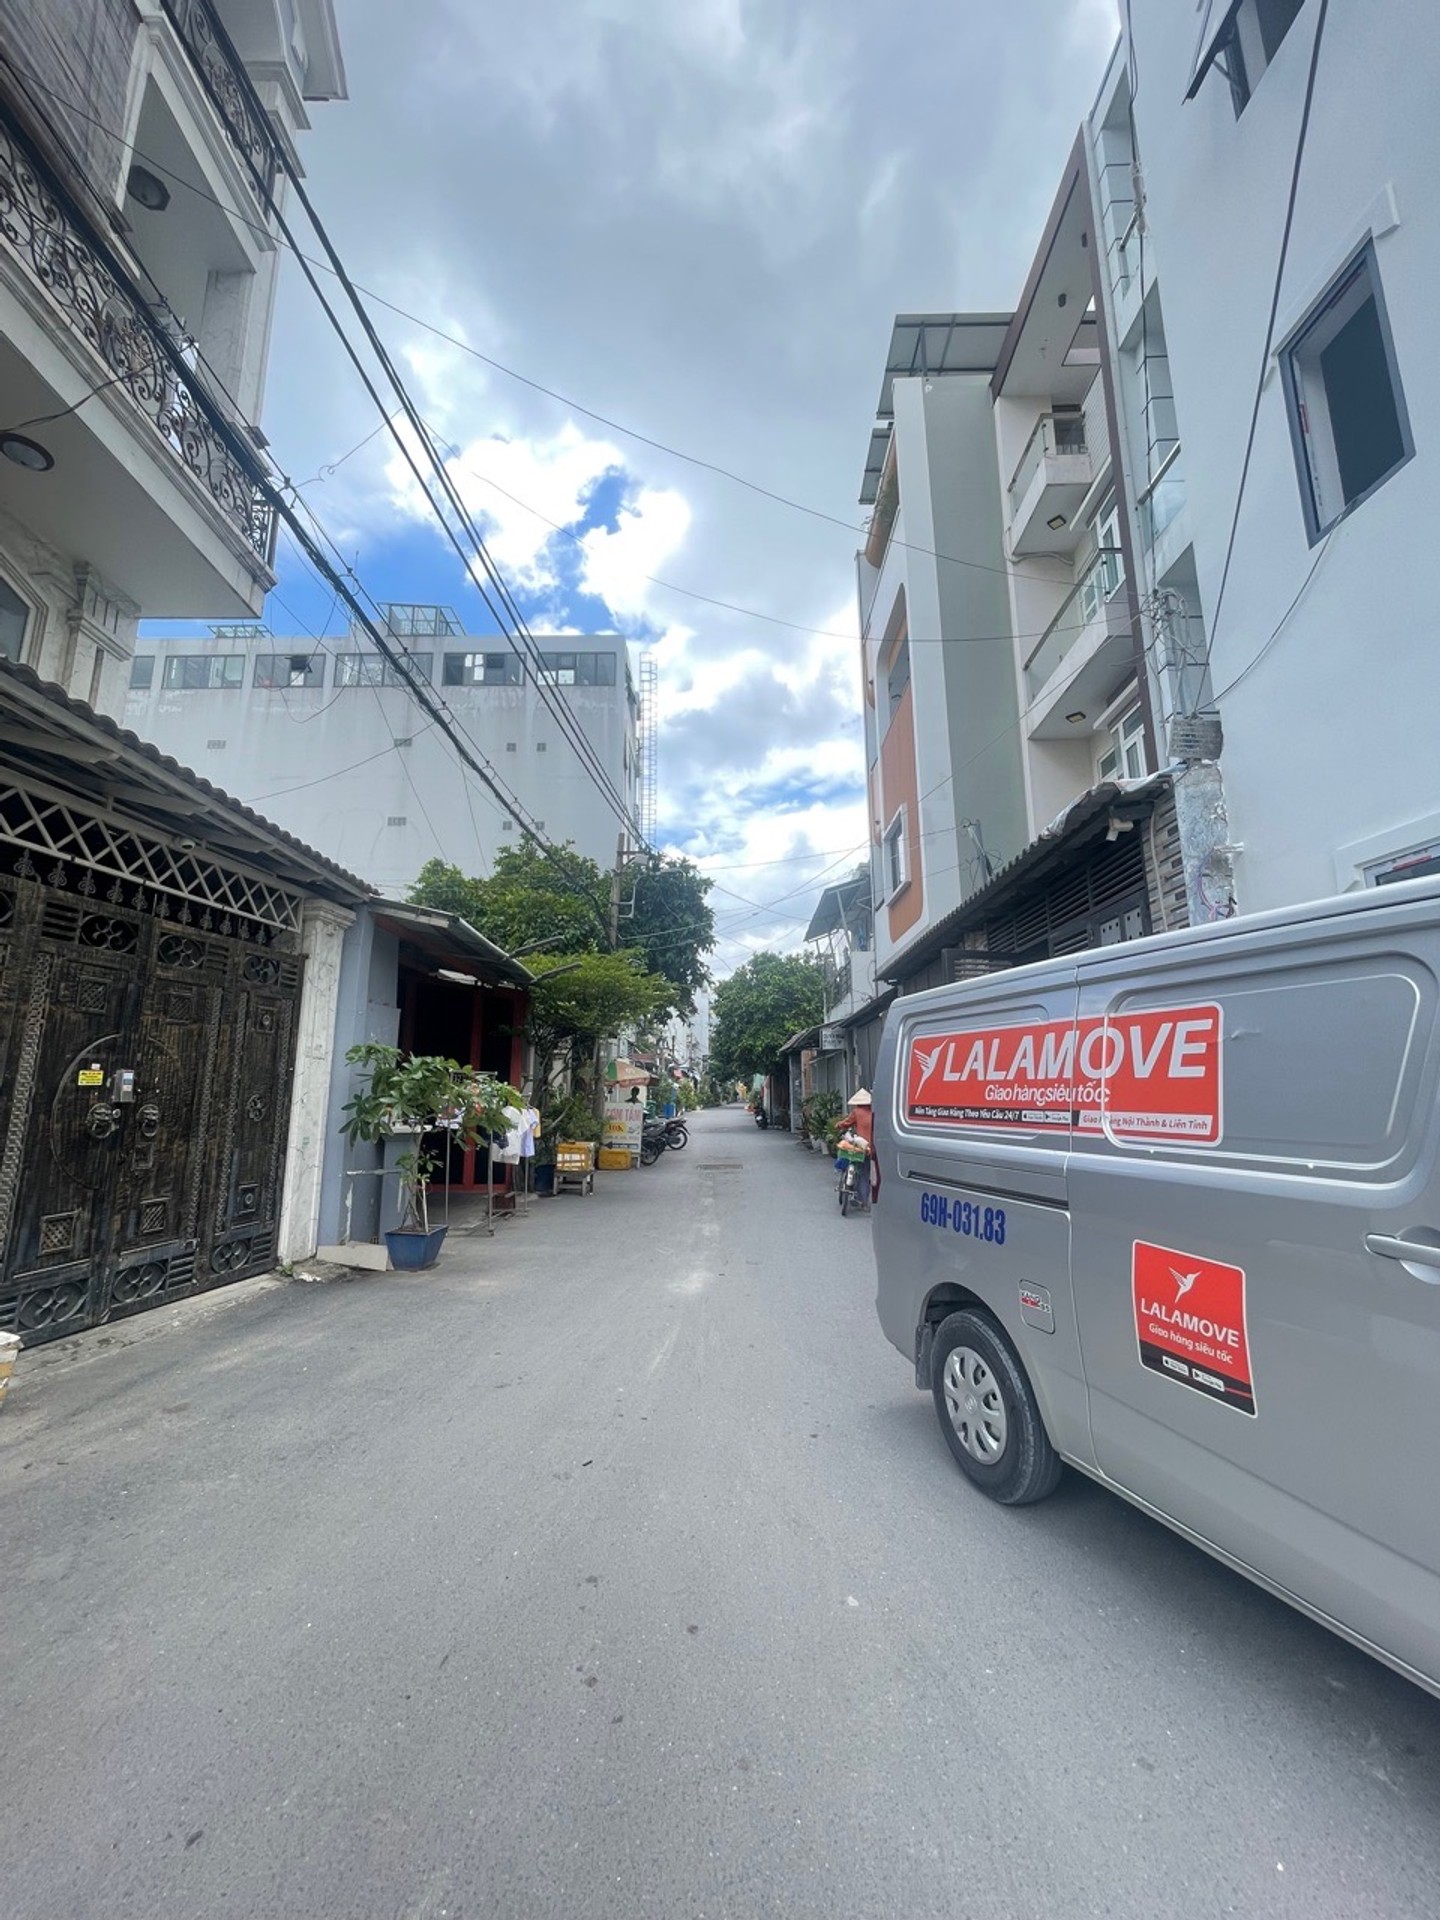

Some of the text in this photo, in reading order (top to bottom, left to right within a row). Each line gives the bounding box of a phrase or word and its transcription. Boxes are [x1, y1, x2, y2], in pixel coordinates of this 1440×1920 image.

[942, 1018, 1213, 1081] LALAMOVE
[985, 1084, 1012, 1101] Giao
[1012, 1083, 1045, 1106] hàng
[1077, 1081, 1111, 1103] tốc
[1004, 1110, 1020, 1121] 24/7
[1136, 1116, 1160, 1127] Thành
[1161, 1119, 1168, 1127] &
[1169, 1118, 1186, 1128] Liên
[921, 1192, 1006, 1245] 69H-031.83
[1141, 1297, 1239, 1348] LALAMOVE
[1149, 1323, 1168, 1338] Giao
[1170, 1329, 1193, 1351] hàng
[1195, 1341, 1215, 1357] siêu
